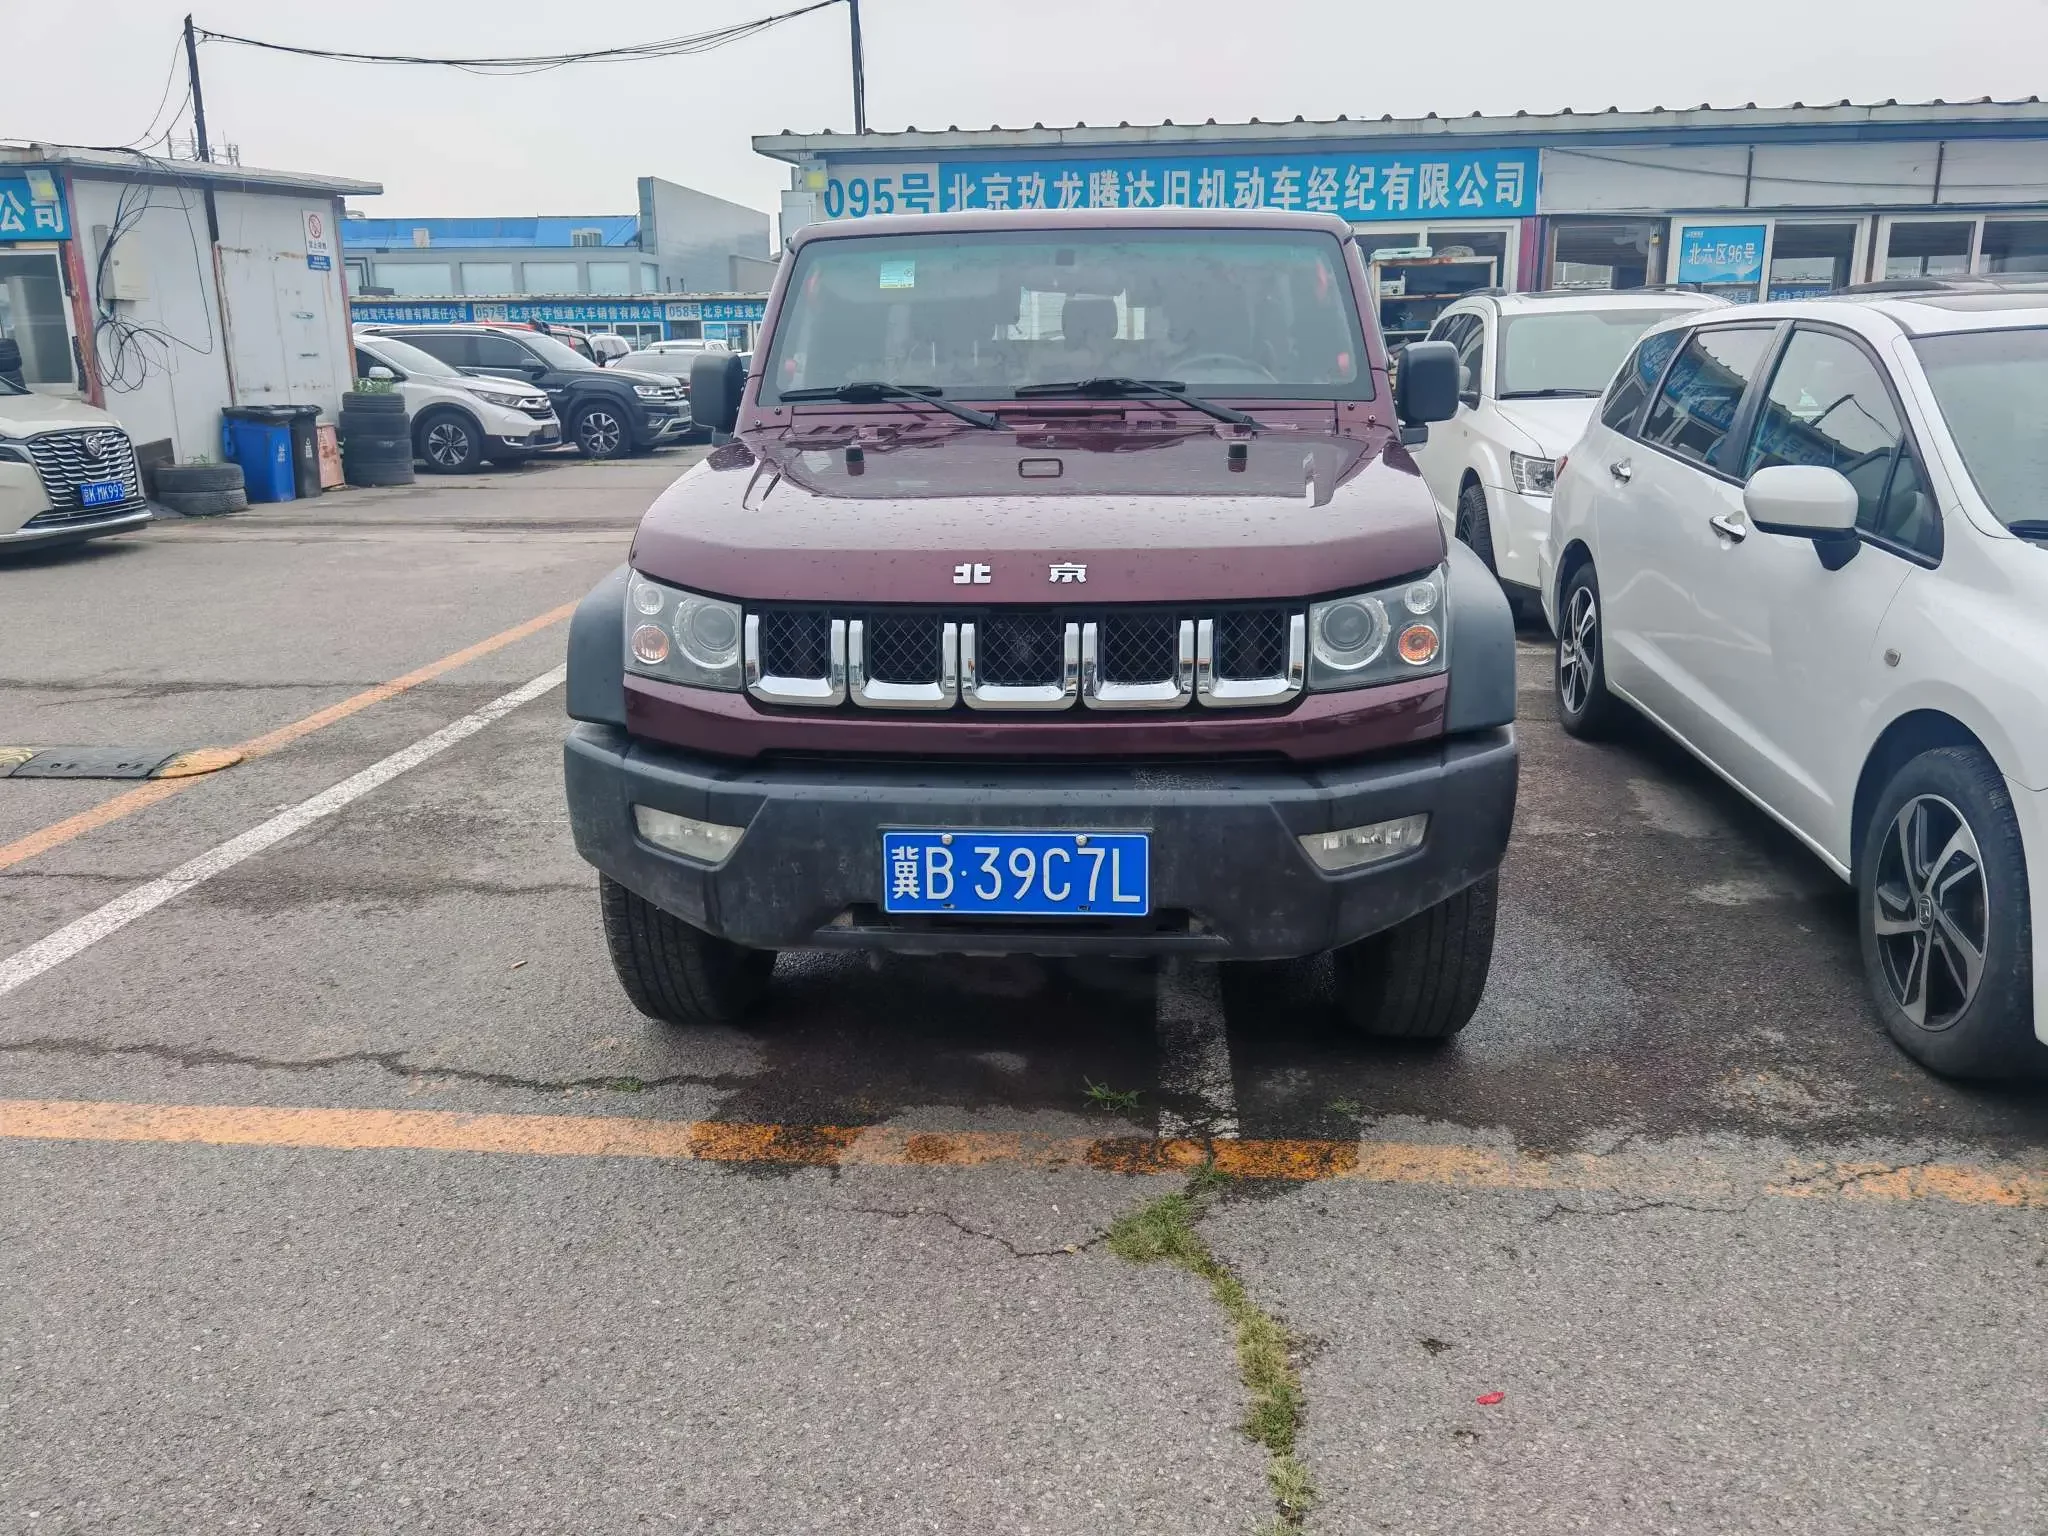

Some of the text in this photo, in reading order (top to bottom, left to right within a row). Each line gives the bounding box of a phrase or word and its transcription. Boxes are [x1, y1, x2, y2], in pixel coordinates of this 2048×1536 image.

[824, 161, 1525, 218] 095号 北京玖龙腾达旧机动车经纪有限公司
[0, 190, 64, 233] 公司
[1688, 242, 1756, 265] 北六区96号
[669, 304, 699, 318] 058号
[891, 845, 1141, 903] 冀B·39C7L
